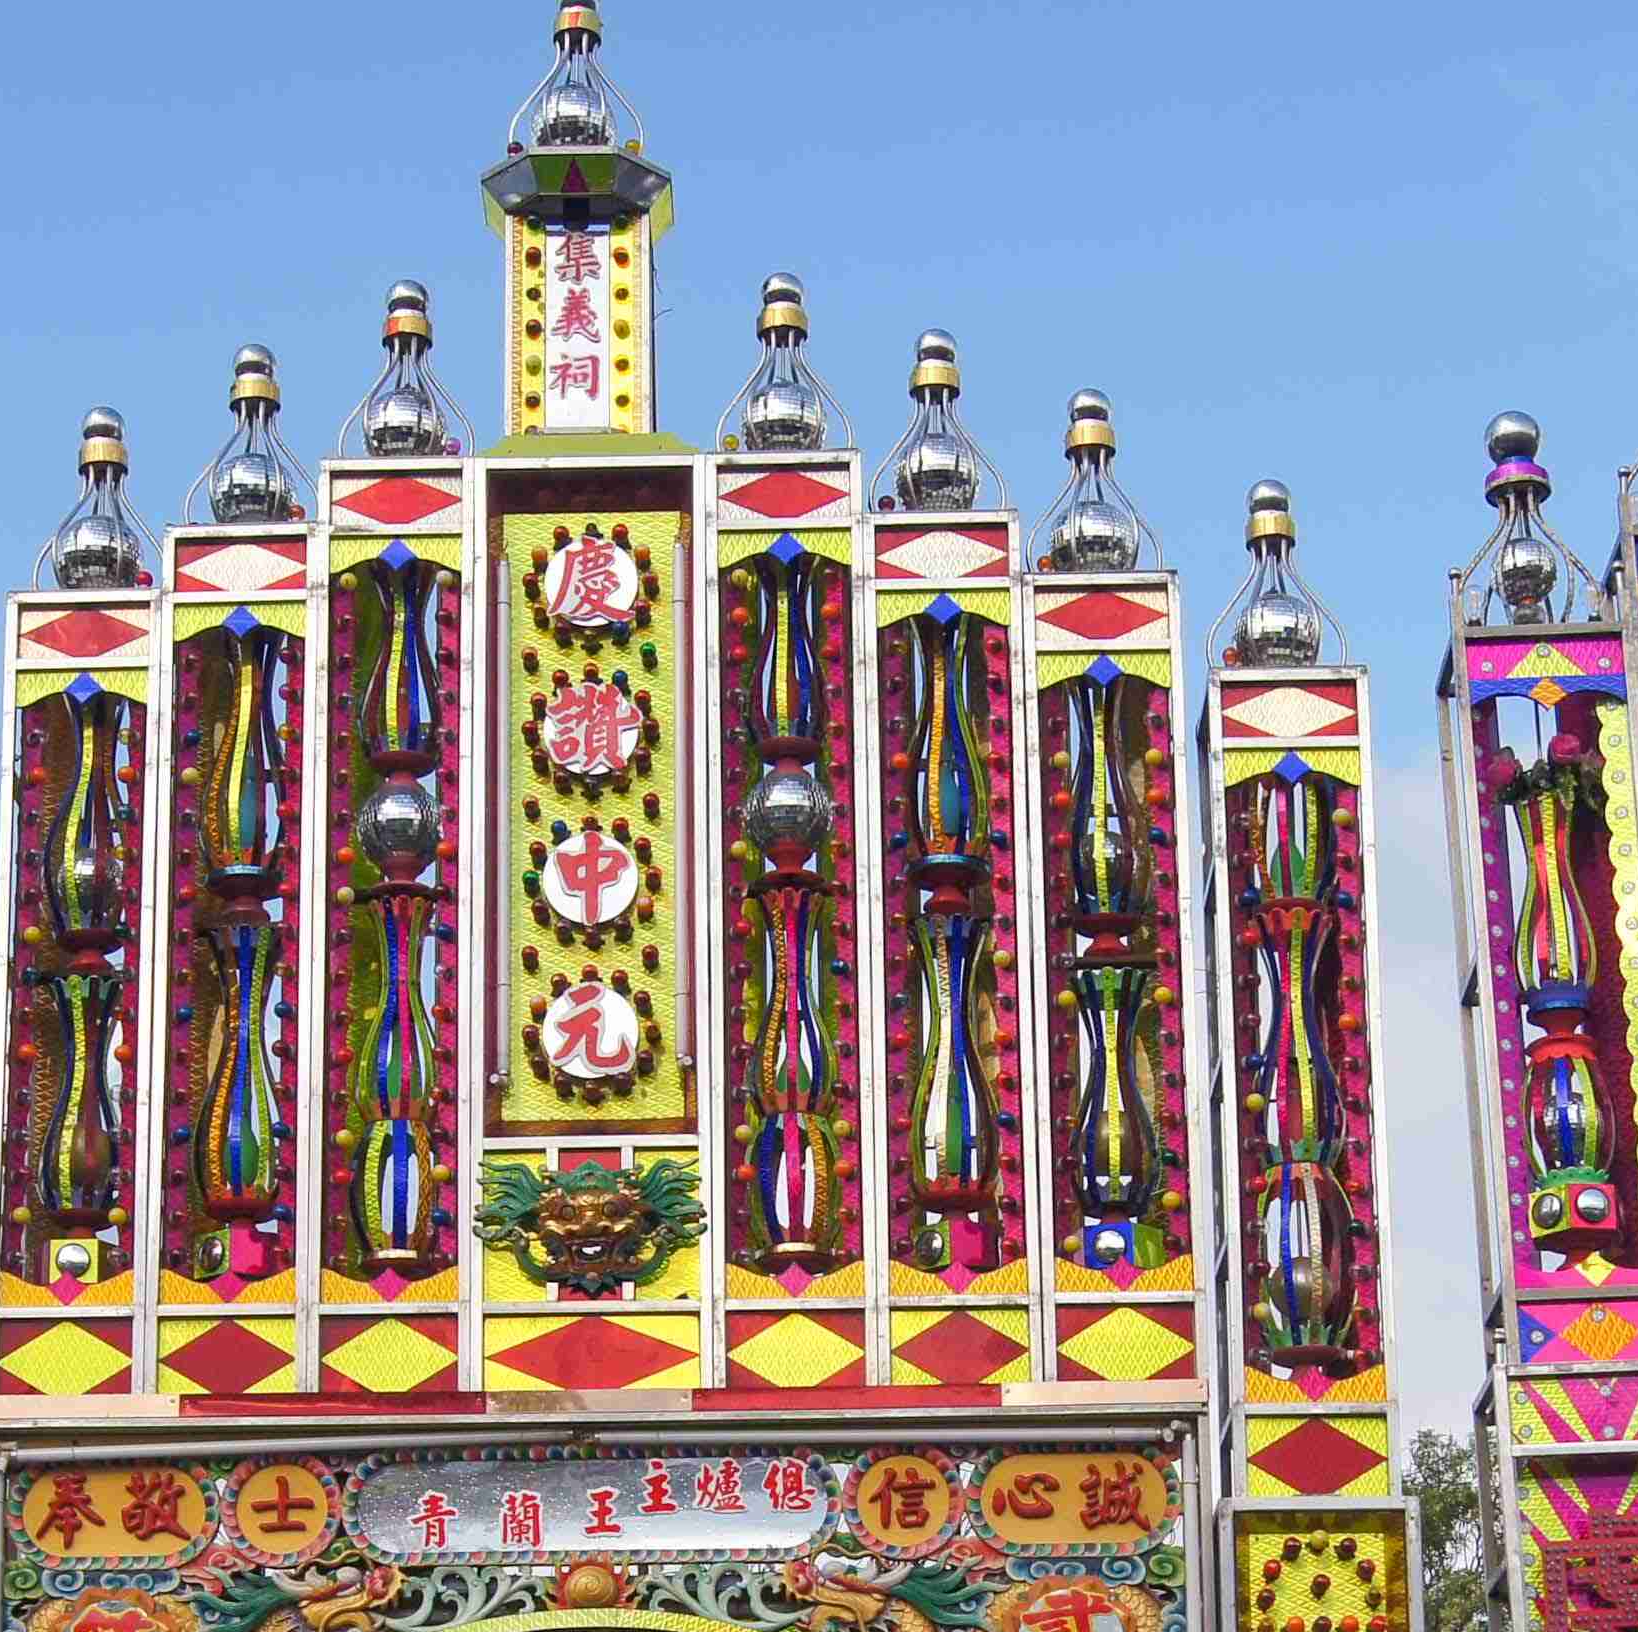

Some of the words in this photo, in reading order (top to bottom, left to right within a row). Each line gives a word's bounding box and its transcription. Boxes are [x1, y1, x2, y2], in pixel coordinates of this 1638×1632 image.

[550, 229, 600, 399] 集義祠
[549, 537, 640, 1074] 慶讚中元
